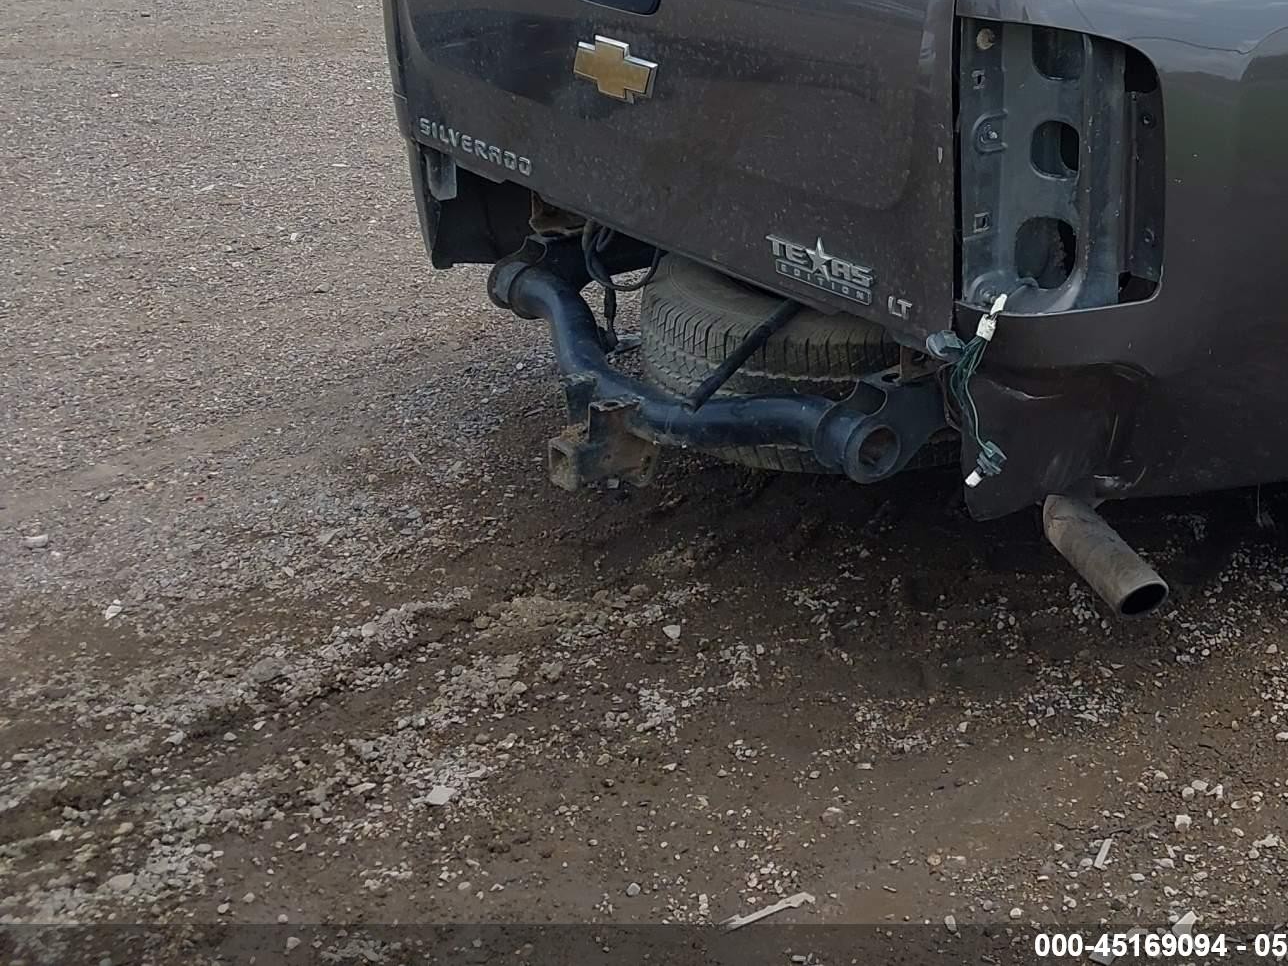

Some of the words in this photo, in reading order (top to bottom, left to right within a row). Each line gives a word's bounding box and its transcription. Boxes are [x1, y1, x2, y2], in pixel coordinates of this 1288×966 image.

[420, 117, 532, 177] SILVERADO
[765, 234, 874, 288] TEXAS
[780, 264, 865, 300] EDITION
[888, 295, 912, 320] LT
